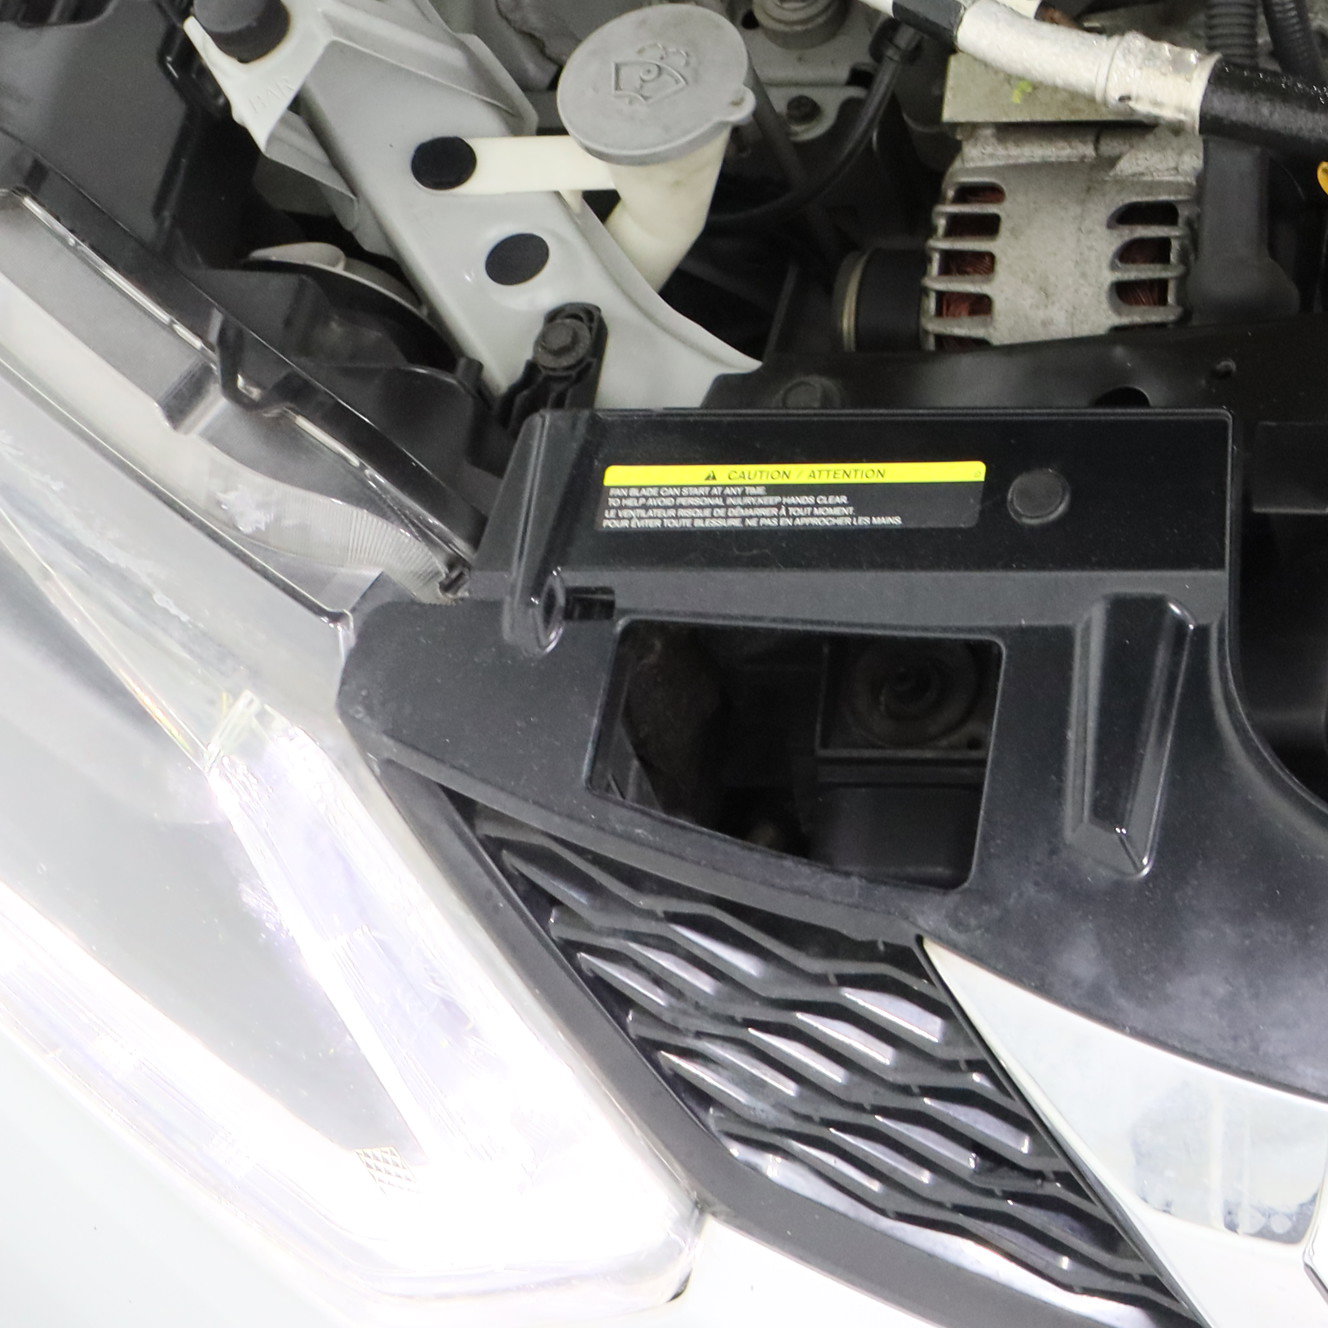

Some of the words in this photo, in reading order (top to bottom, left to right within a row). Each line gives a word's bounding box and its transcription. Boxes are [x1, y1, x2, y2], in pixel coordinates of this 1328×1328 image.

[727, 469, 792, 481] CAUTION
[808, 468, 886, 480] ATTENTION
[608, 487, 628, 497] FAN
[629, 487, 659, 497] BLADE
[659, 487, 681, 497] CAN
[681, 487, 710, 497] START
[710, 487, 723, 496] AT
[723, 487, 744, 496] ANY
[607, 497, 621, 507] TO
[621, 497, 646, 507] HELP
[646, 497, 675, 507] AVOID
[675, 497, 725, 506] PERSONAL
[782, 495, 816, 505] HANDS
[604, 509, 617, 518] LE
[617, 508, 677, 518] VENTILATEUR
[677, 508, 712, 518] RISQUE
[712, 508, 726, 517] DE
[788, 507, 813, 516] TOUT
[602, 519, 630, 528] POUR
[663, 519, 693, 528] TOUTE
[744, 518, 759, 527] NE
[759, 517, 779, 527] PAS
[779, 517, 793, 526] EN
[793, 517, 852, 526] APPROCHER
[853, 517, 871, 525] LES
